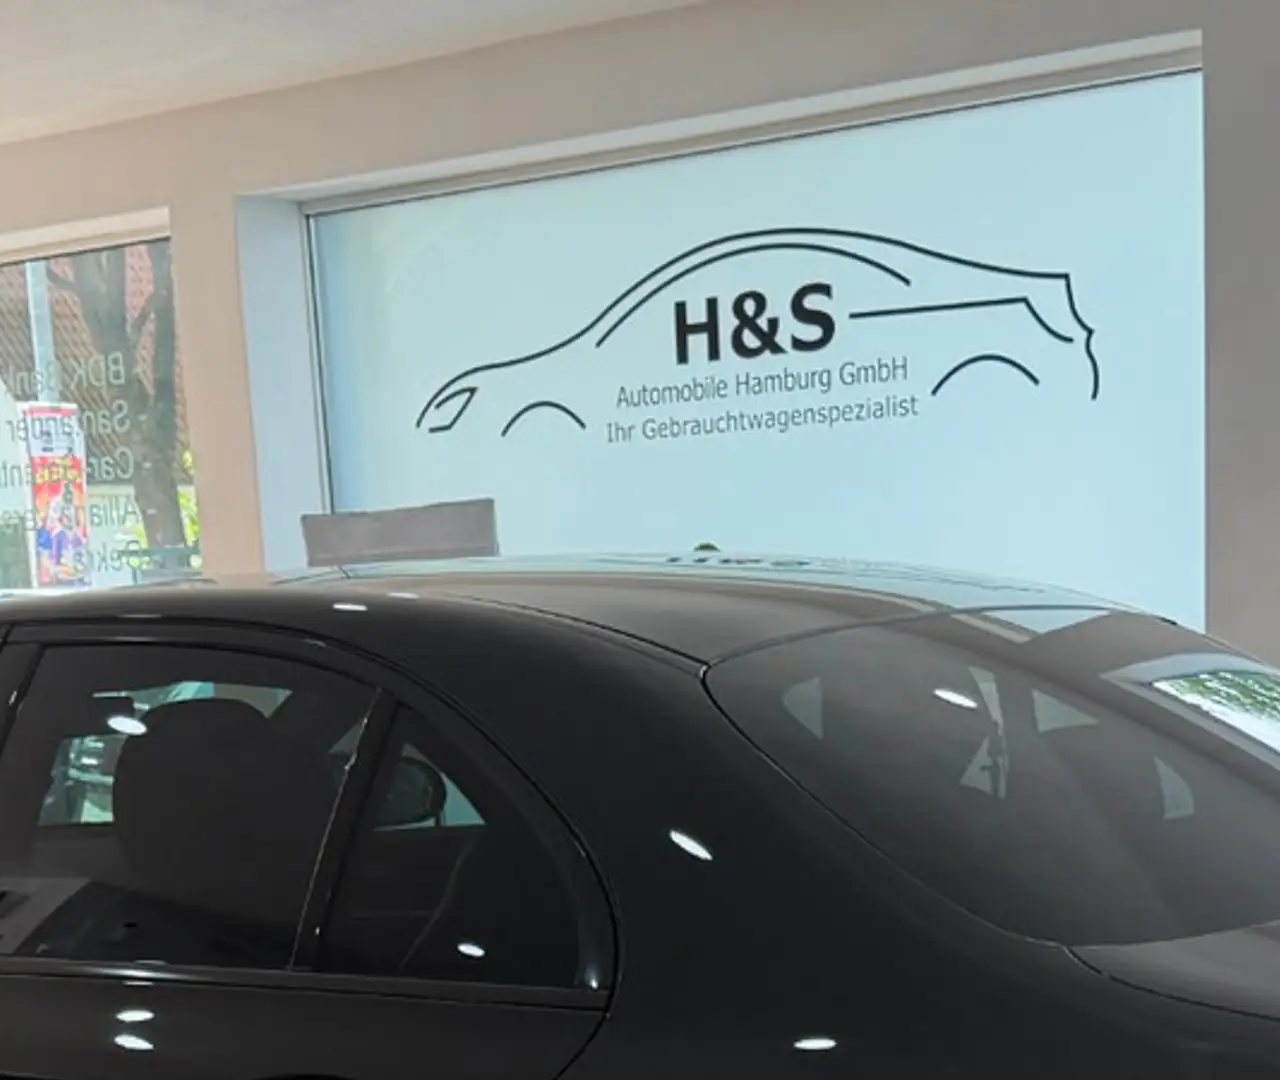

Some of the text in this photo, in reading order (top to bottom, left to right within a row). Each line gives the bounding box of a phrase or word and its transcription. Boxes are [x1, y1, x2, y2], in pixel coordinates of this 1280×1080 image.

[674, 282, 836, 365] H&S
[616, 355, 909, 408] Automobile Hamburg GmbH
[606, 394, 920, 443] Ihr Gebrauchtwagenspezialist
